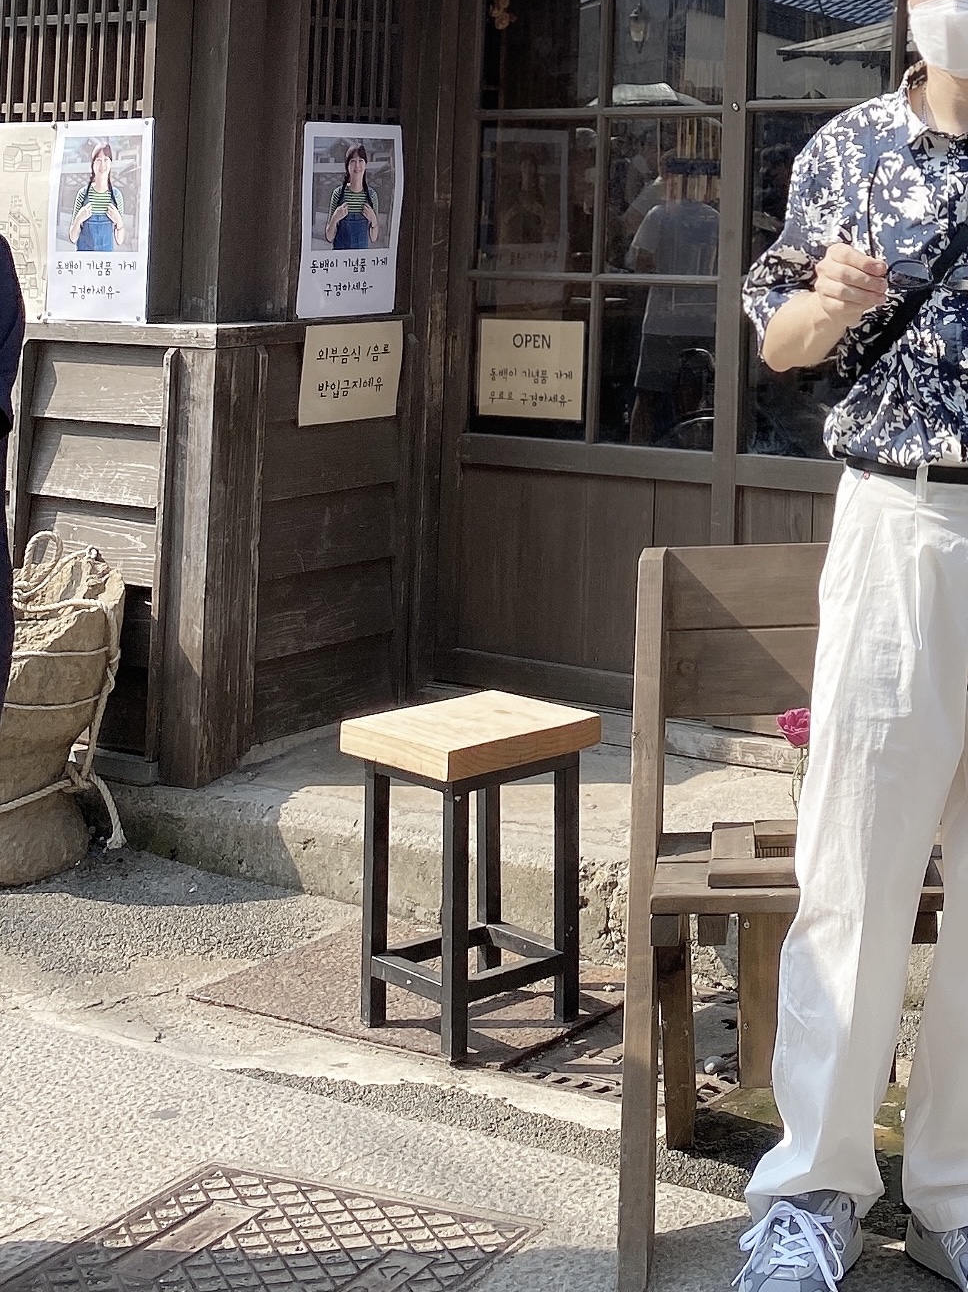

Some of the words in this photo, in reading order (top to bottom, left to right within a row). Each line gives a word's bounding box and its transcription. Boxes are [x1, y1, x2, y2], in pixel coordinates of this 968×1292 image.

[55, 260, 82, 276] 동백이
[86, 260, 113, 276] 기념품
[118, 260, 138, 271] 가게
[309, 258, 338, 274] 동백이
[343, 257, 367, 273] 기념품
[371, 256, 388, 267] 가게
[512, 333, 551, 349] OPEN
[316, 345, 362, 365] 외부음식
[489, 367, 517, 382] 동백이
[522, 368, 549, 385] 기념품
[554, 370, 573, 380] 가게
[317, 376, 384, 399] 반입금지예유
